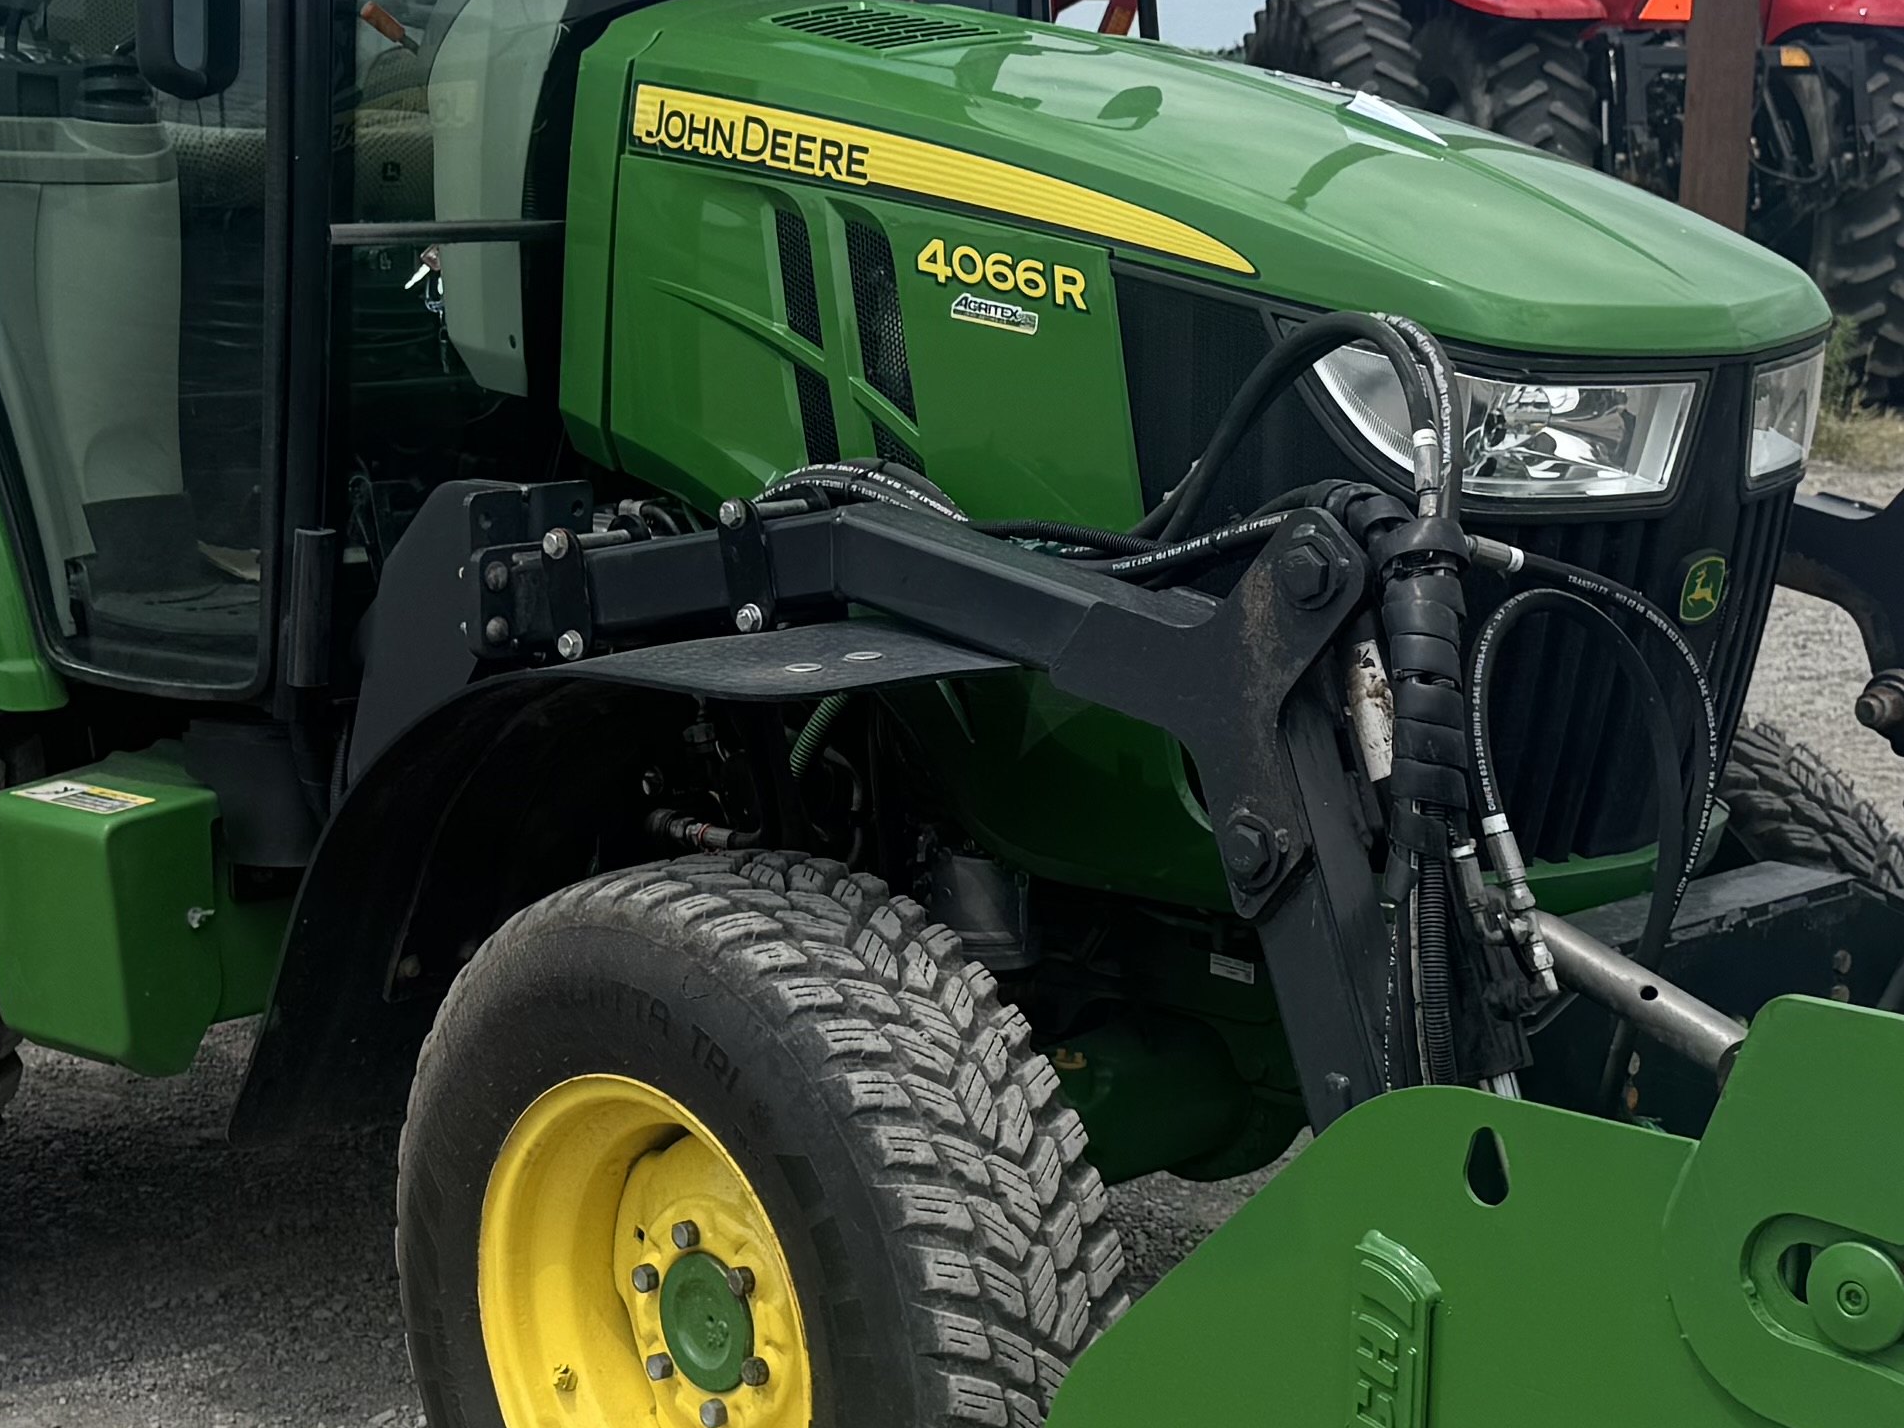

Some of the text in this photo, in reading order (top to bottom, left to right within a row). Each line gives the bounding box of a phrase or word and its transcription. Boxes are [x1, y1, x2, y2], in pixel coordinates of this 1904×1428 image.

[645, 99, 870, 180] JOHN DEERE
[954, 295, 1020, 320] AGRITEX
